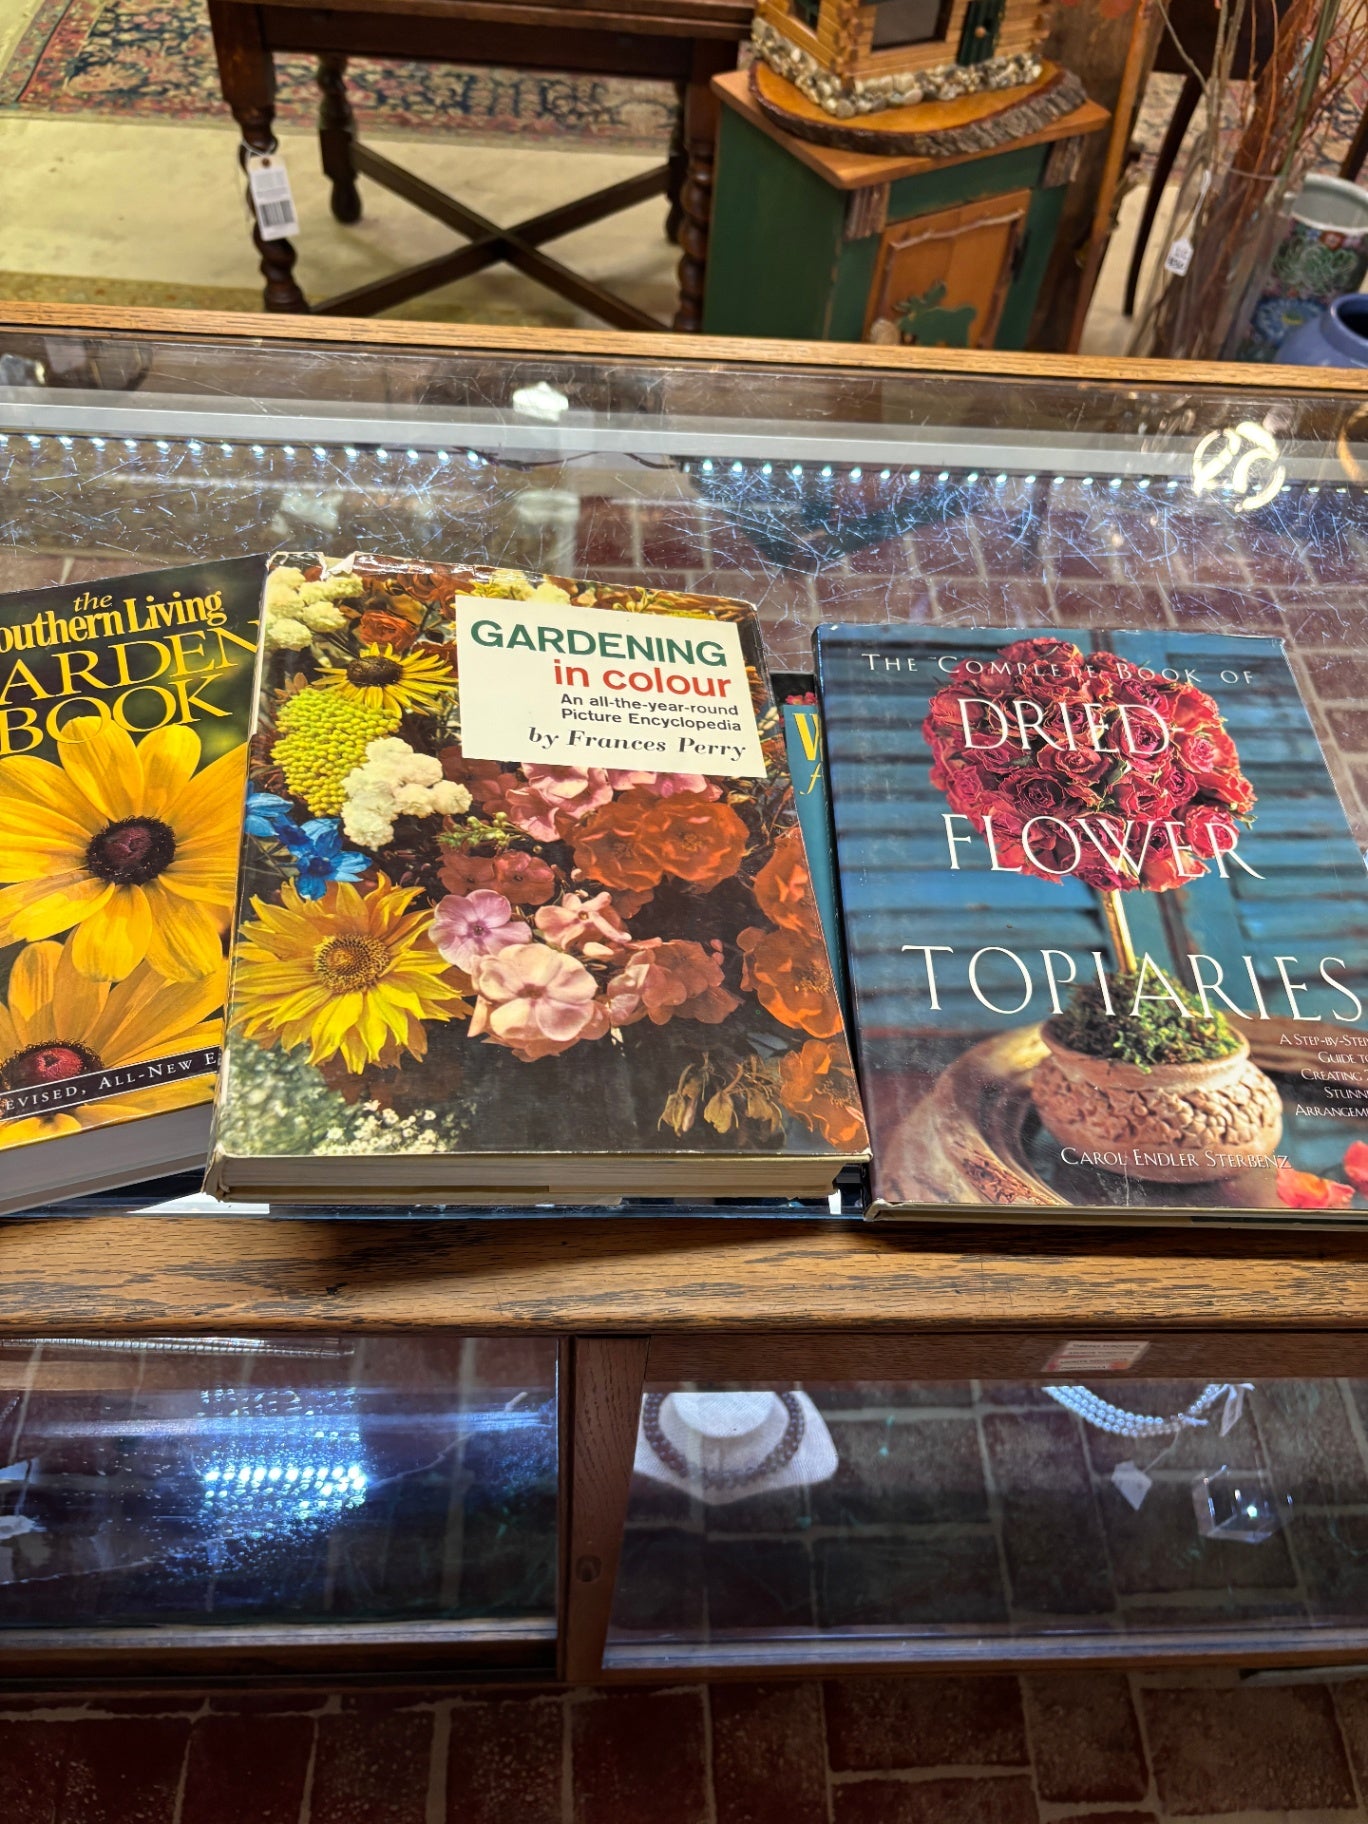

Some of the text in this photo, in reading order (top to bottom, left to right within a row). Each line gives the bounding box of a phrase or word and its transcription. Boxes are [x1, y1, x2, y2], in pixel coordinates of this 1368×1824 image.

[73, 592, 113, 612] the
[470, 619, 728, 667] GARDENING
[554, 658, 732, 698] in colour
[861, 653, 1254, 685] THE COMPLETE BOOK OF
[0, 672, 233, 755] BOOK
[561, 693, 739, 716] An all-the-year-round
[562, 708, 742, 732] Picture Encyclopedia
[528, 727, 746, 762] by Frances Perry
[941, 813, 1266, 880] FLOWER
[902, 944, 1363, 1022] TOPIARIES
[1280, 1033, 1293, 1046] A
[1318, 1051, 1357, 1064] GUIDE
[98, 1060, 193, 1090] ALL-NEW
[1301, 1068, 1363, 1081] CREATING
[1060, 1147, 1293, 1170] CAROL ENDLER STERBENZ
